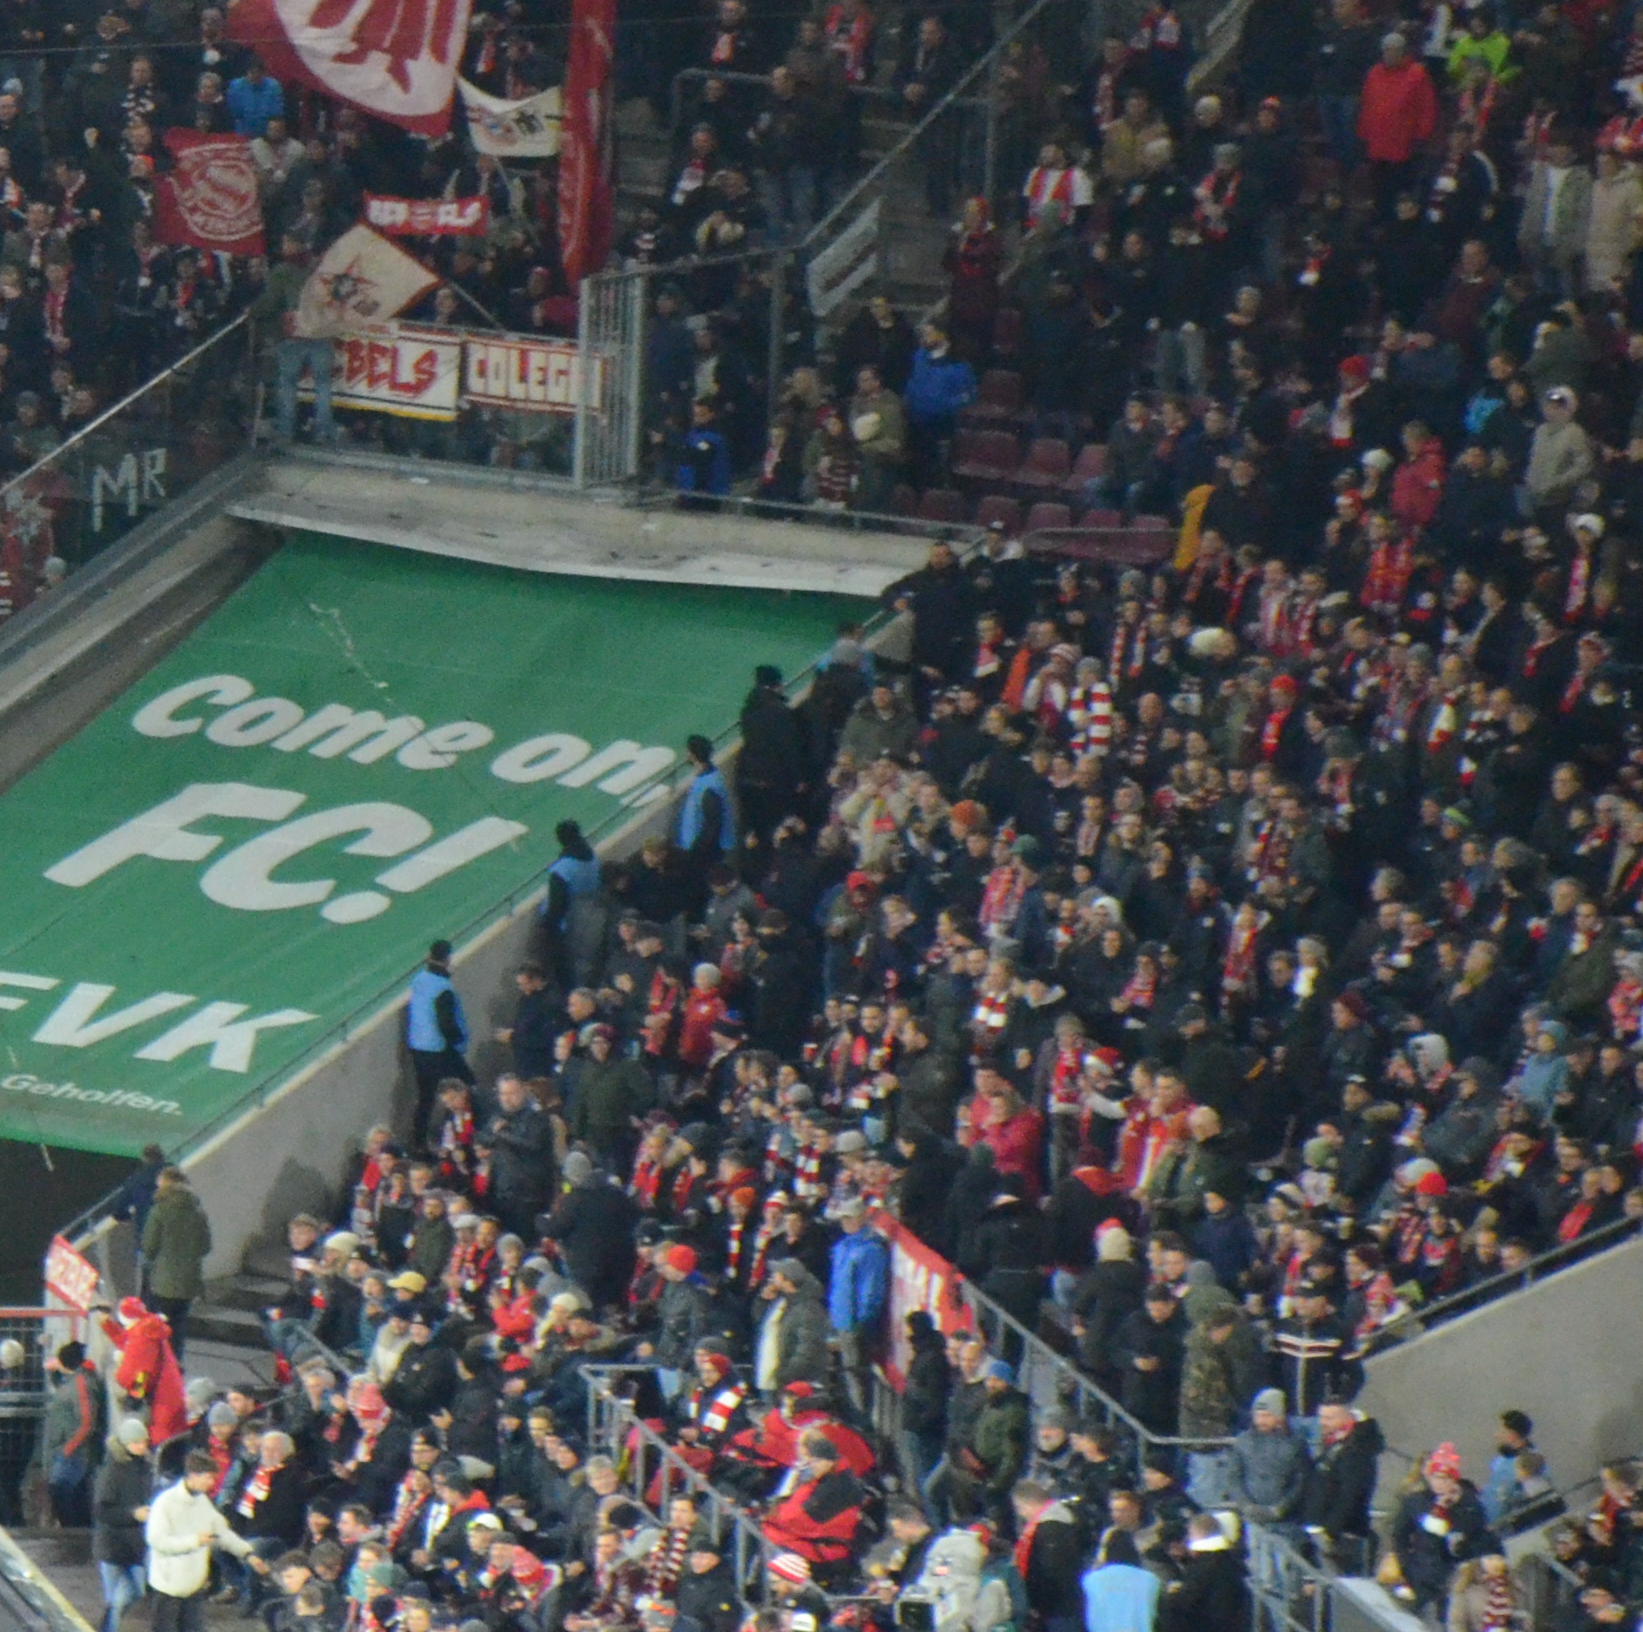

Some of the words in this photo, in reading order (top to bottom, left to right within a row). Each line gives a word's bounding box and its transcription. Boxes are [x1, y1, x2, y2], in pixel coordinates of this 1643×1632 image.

[132, 674, 495, 770] Come
[43, 780, 527, 925] FC!
[0, 1073, 183, 1116] Geholfen.
